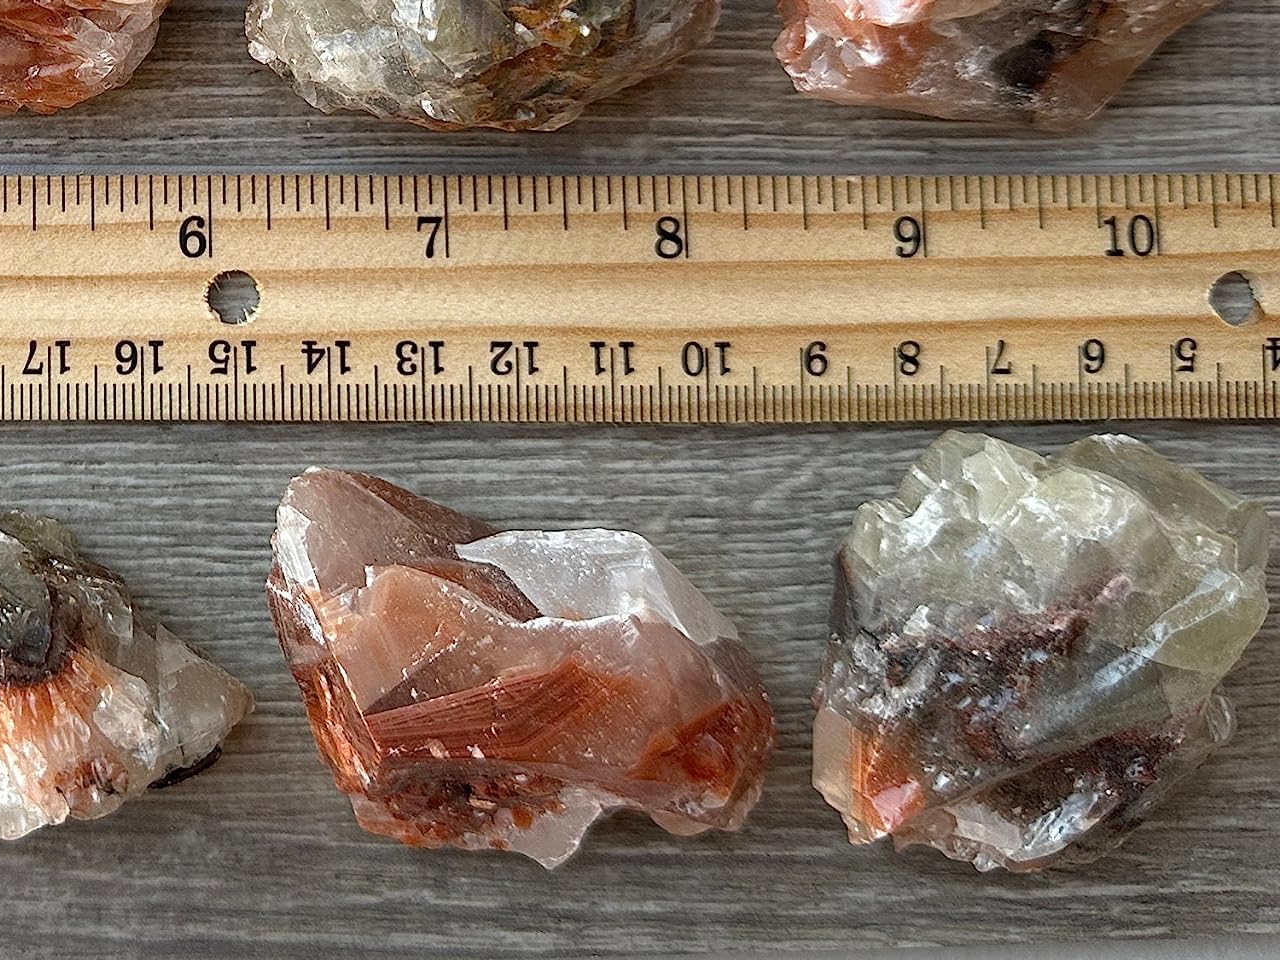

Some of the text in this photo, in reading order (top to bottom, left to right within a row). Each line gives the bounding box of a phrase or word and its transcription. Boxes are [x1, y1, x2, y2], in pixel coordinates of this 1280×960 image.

[178, 215, 207, 259] 6
[416, 215, 444, 259] 7
[654, 215, 684, 260] 8
[893, 215, 923, 259] 9
[1102, 214, 1156, 258] 10
[21, 340, 71, 376] 17
[114, 340, 165, 376] 16
[208, 340, 258, 376] 15
[300, 340, 352, 376] 14
[395, 340, 446, 376] 13
[489, 340, 540, 376] 12
[589, 341, 636, 376] 11
[681, 340, 733, 377] 10
[803, 340, 829, 378] 9
[896, 340, 922, 377] 8
[990, 339, 1013, 376] 7
[1081, 338, 1107, 374] 6
[1174, 337, 1198, 373] 5
